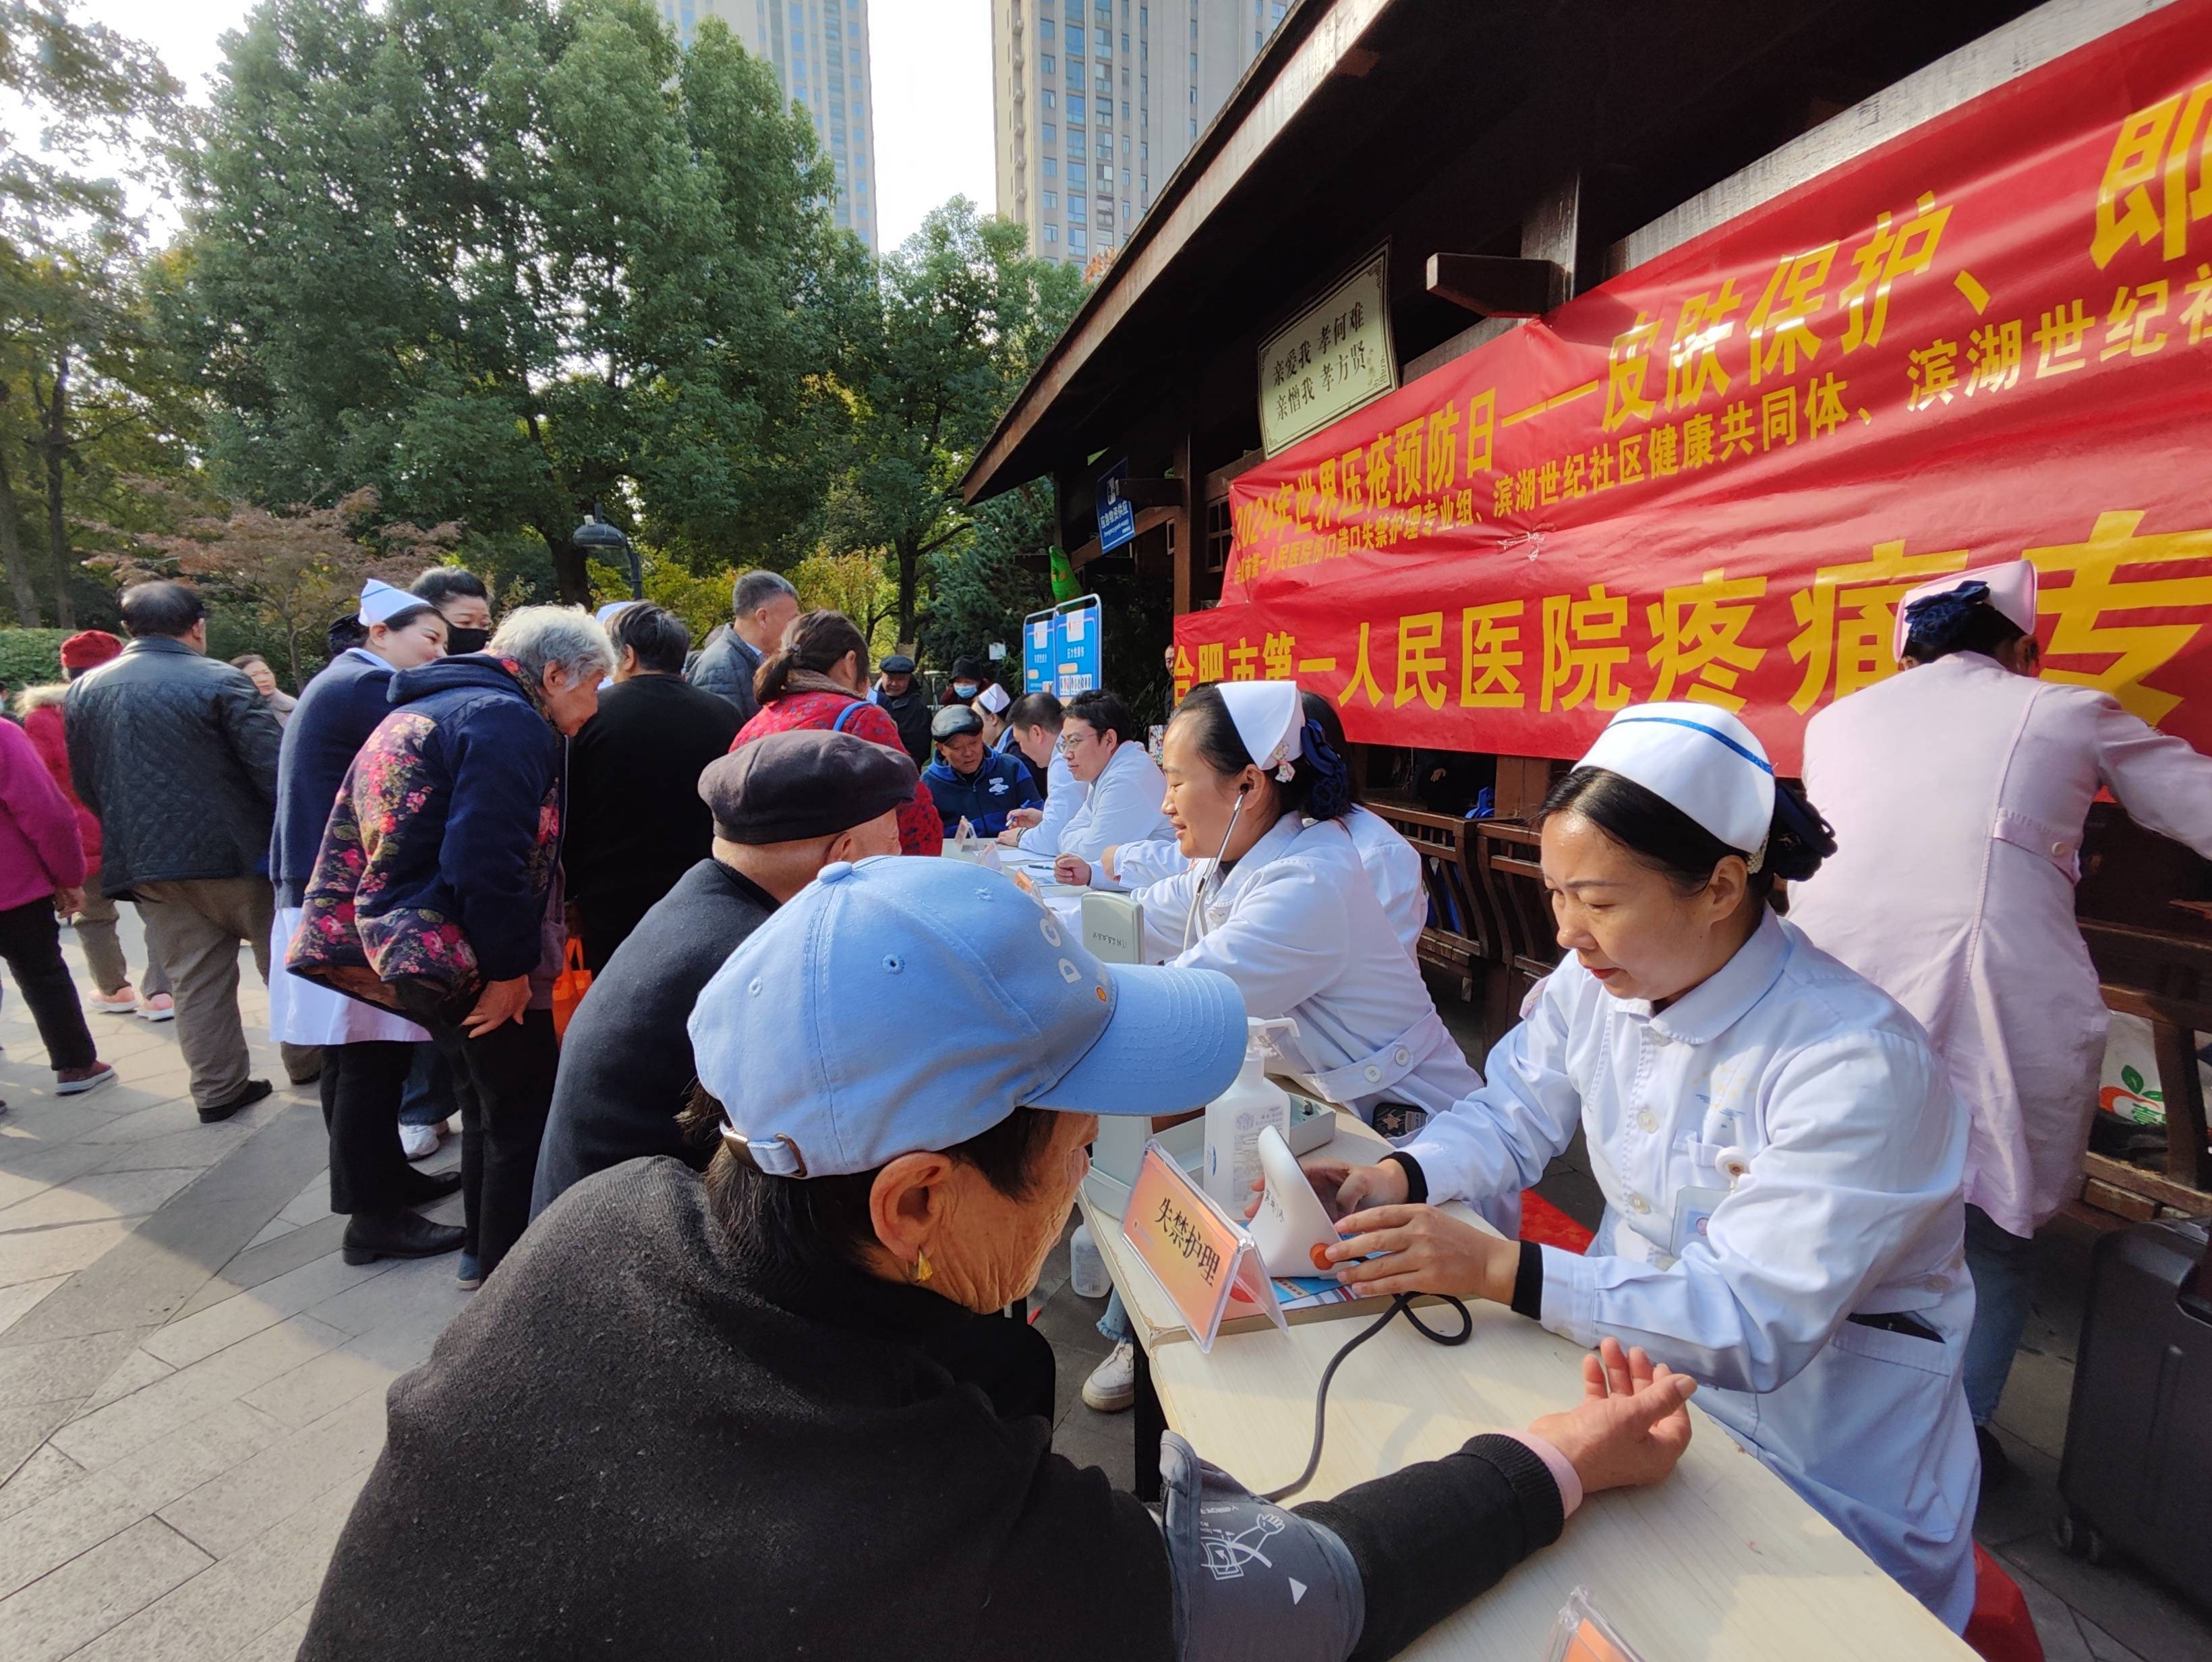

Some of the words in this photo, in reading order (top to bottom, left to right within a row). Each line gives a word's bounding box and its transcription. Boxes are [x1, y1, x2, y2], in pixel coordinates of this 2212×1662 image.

[1273, 340, 1311, 387] 亲爱我
[1318, 302, 1364, 355] 孝何难
[1319, 339, 1366, 393] 孝方贤
[1154, 1197, 1221, 1288] 失禁护理
